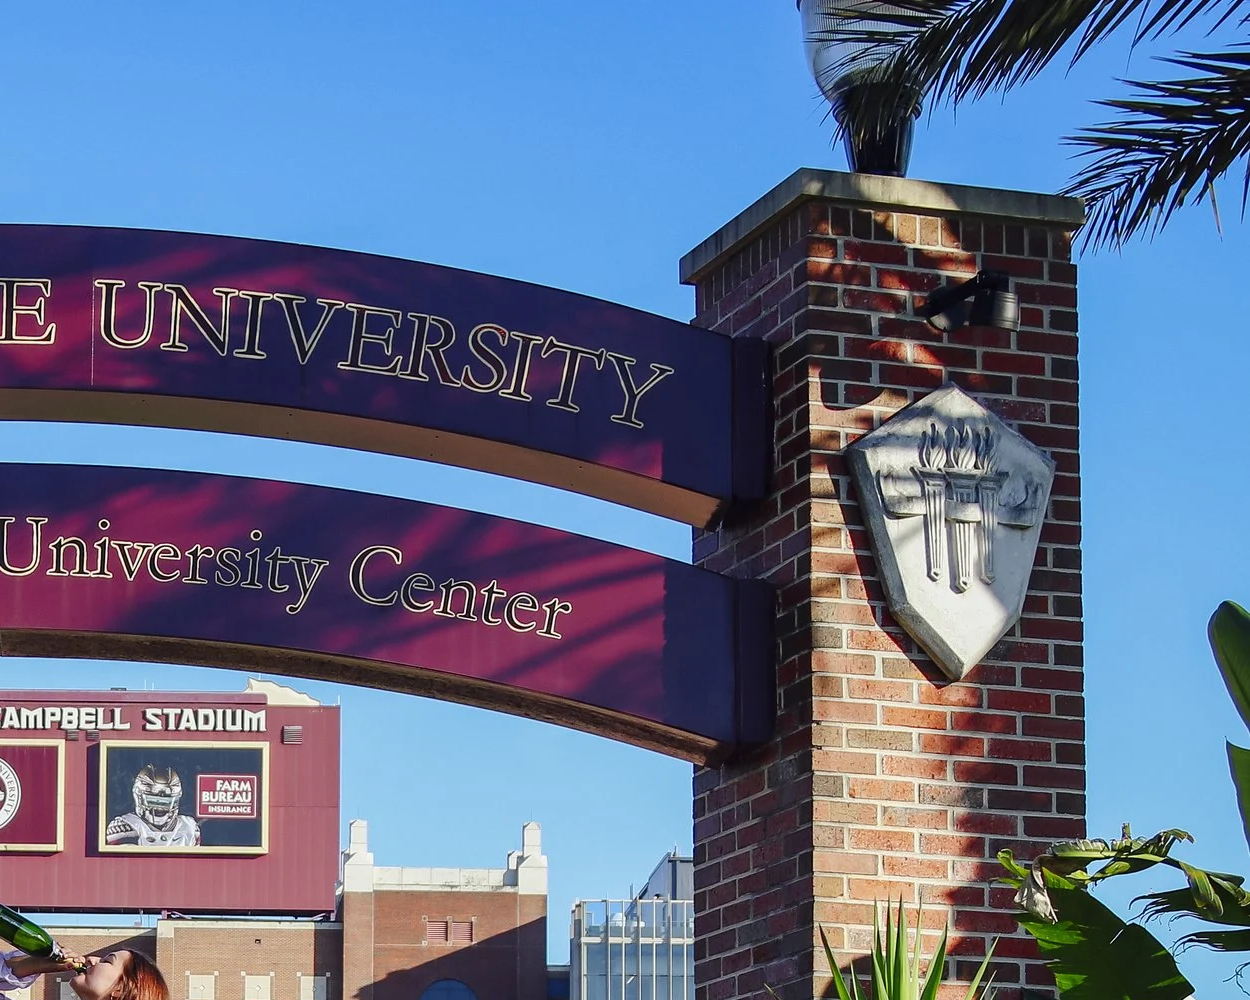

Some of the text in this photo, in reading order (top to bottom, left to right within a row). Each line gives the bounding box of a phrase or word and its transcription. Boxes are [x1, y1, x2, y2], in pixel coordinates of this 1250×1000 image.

[93, 278, 675, 429] UNIVERSITY
[349, 545, 573, 639] Center
[145, 708, 267, 732] STADIUM
[216, 780, 251, 791] FARM
[202, 791, 252, 802] BUREAU
[208, 805, 251, 813] INSURANCE
